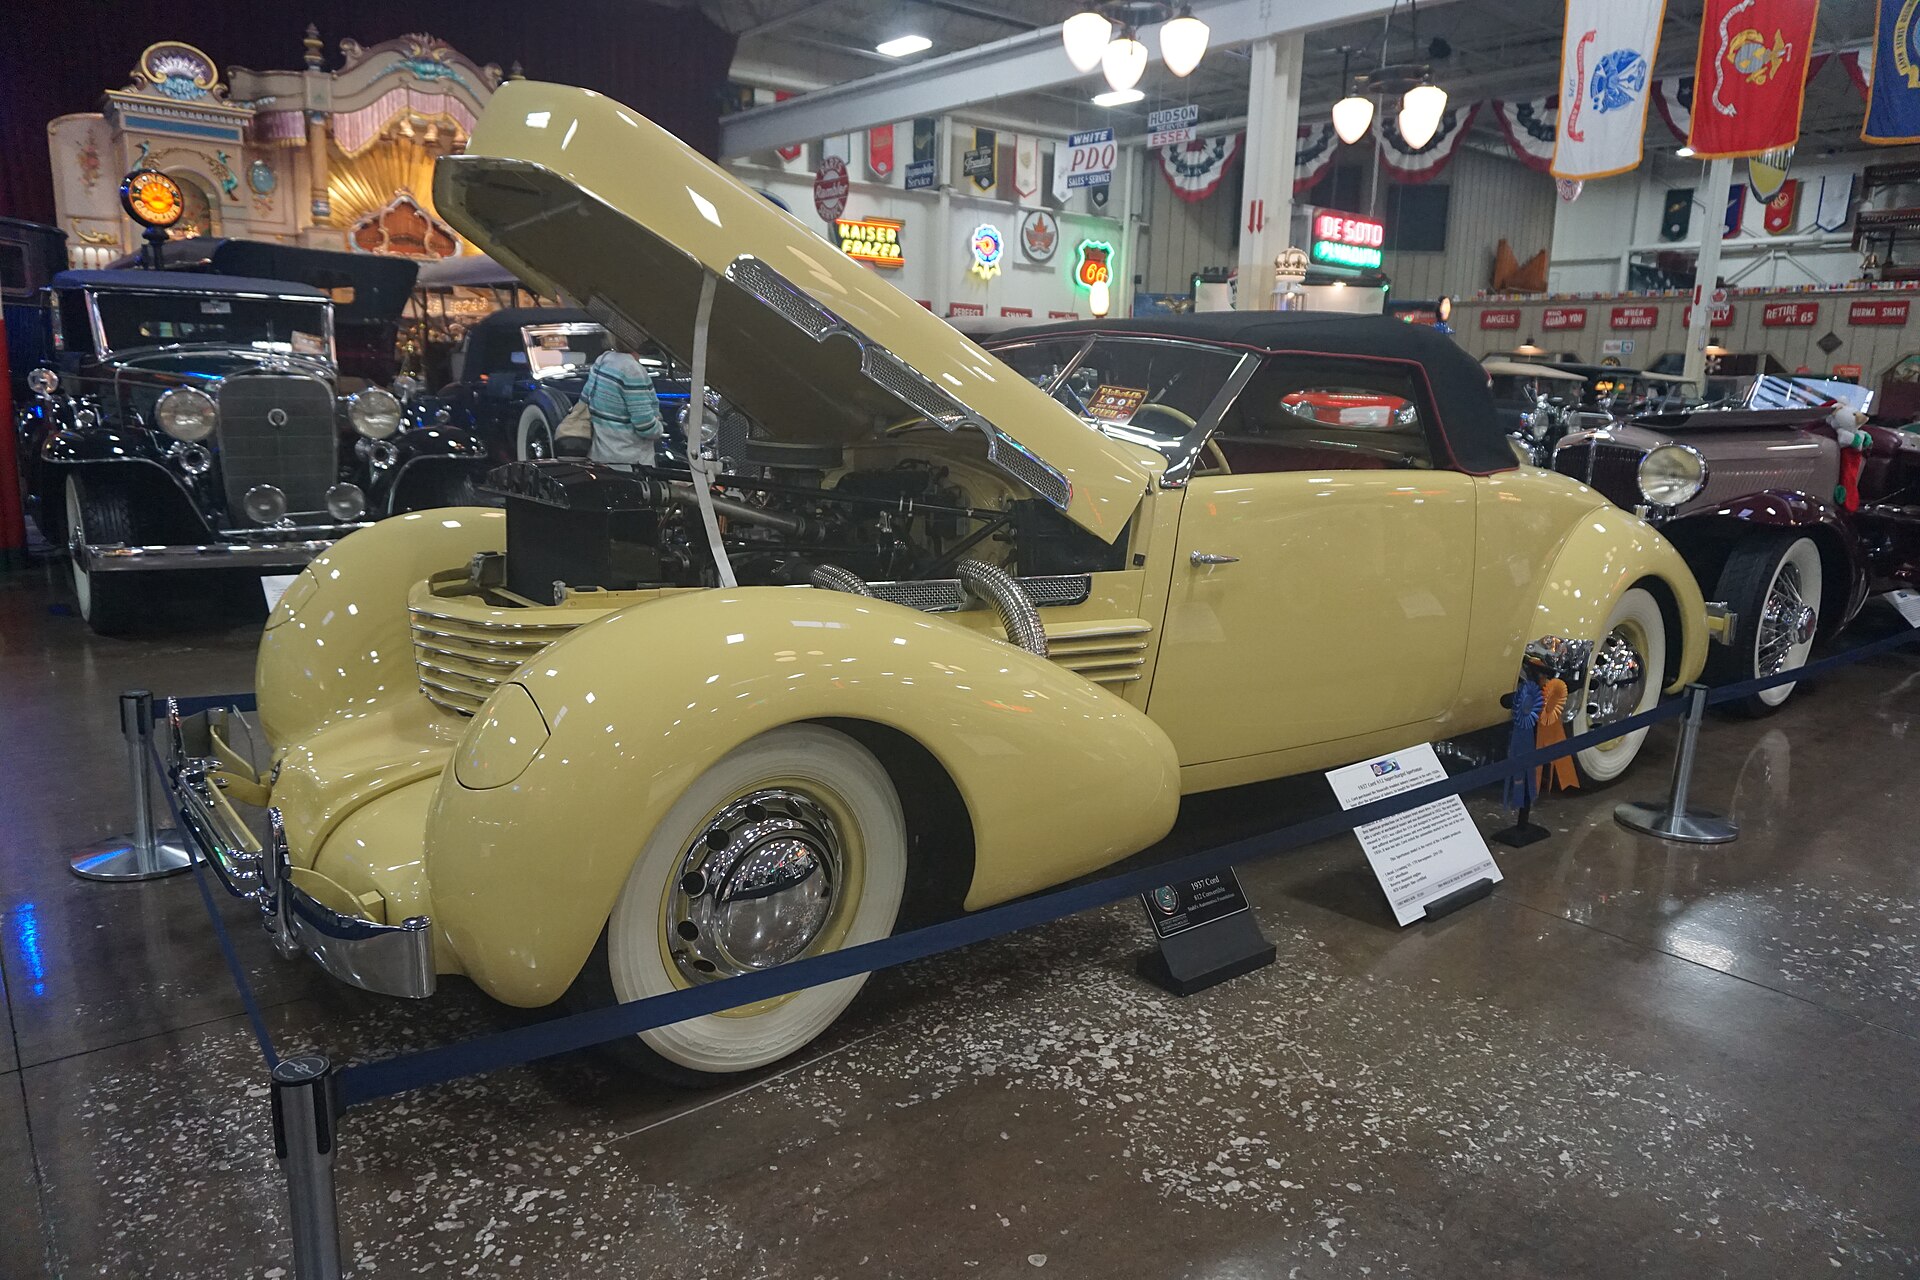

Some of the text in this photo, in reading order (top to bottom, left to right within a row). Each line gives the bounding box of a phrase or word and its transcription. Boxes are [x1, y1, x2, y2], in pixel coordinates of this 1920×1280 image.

[1151, 107, 1198, 125] HUDSON
[1157, 121, 1189, 132] SERVICE
[1073, 130, 1109, 145] WHITE
[1152, 127, 1192, 145] ESSEX
[1070, 143, 1116, 172] PDQ
[820, 157, 845, 176] PARTS
[907, 176, 932, 188] Service
[1068, 177, 1085, 187] SALES
[1088, 172, 1111, 184] SERVICE
[815, 181, 848, 198] Rambler
[134, 199, 180, 223] GASOLINE
[838, 222, 897, 243] KAISER
[1321, 215, 1384, 245] DE SOTO
[841, 239, 901, 258] FRAZER
[1086, 263, 1108, 282] 66
[1485, 313, 1516, 325] ANGELS
[1545, 312, 1583, 327] GUARD YOU
[1623, 307, 1645, 318] WHEN
[1765, 304, 1798, 320] RETIRE
[1785, 310, 1814, 324] AT 65
[1851, 306, 1906, 318] BURMA SHAVE
[1613, 315, 1653, 326] YOU DRIVE
[1097, 394, 1137, 408] LOOK
[1190, 875, 1220, 891] 1937 Cord
[1202, 886, 1226, 898] Convertible
